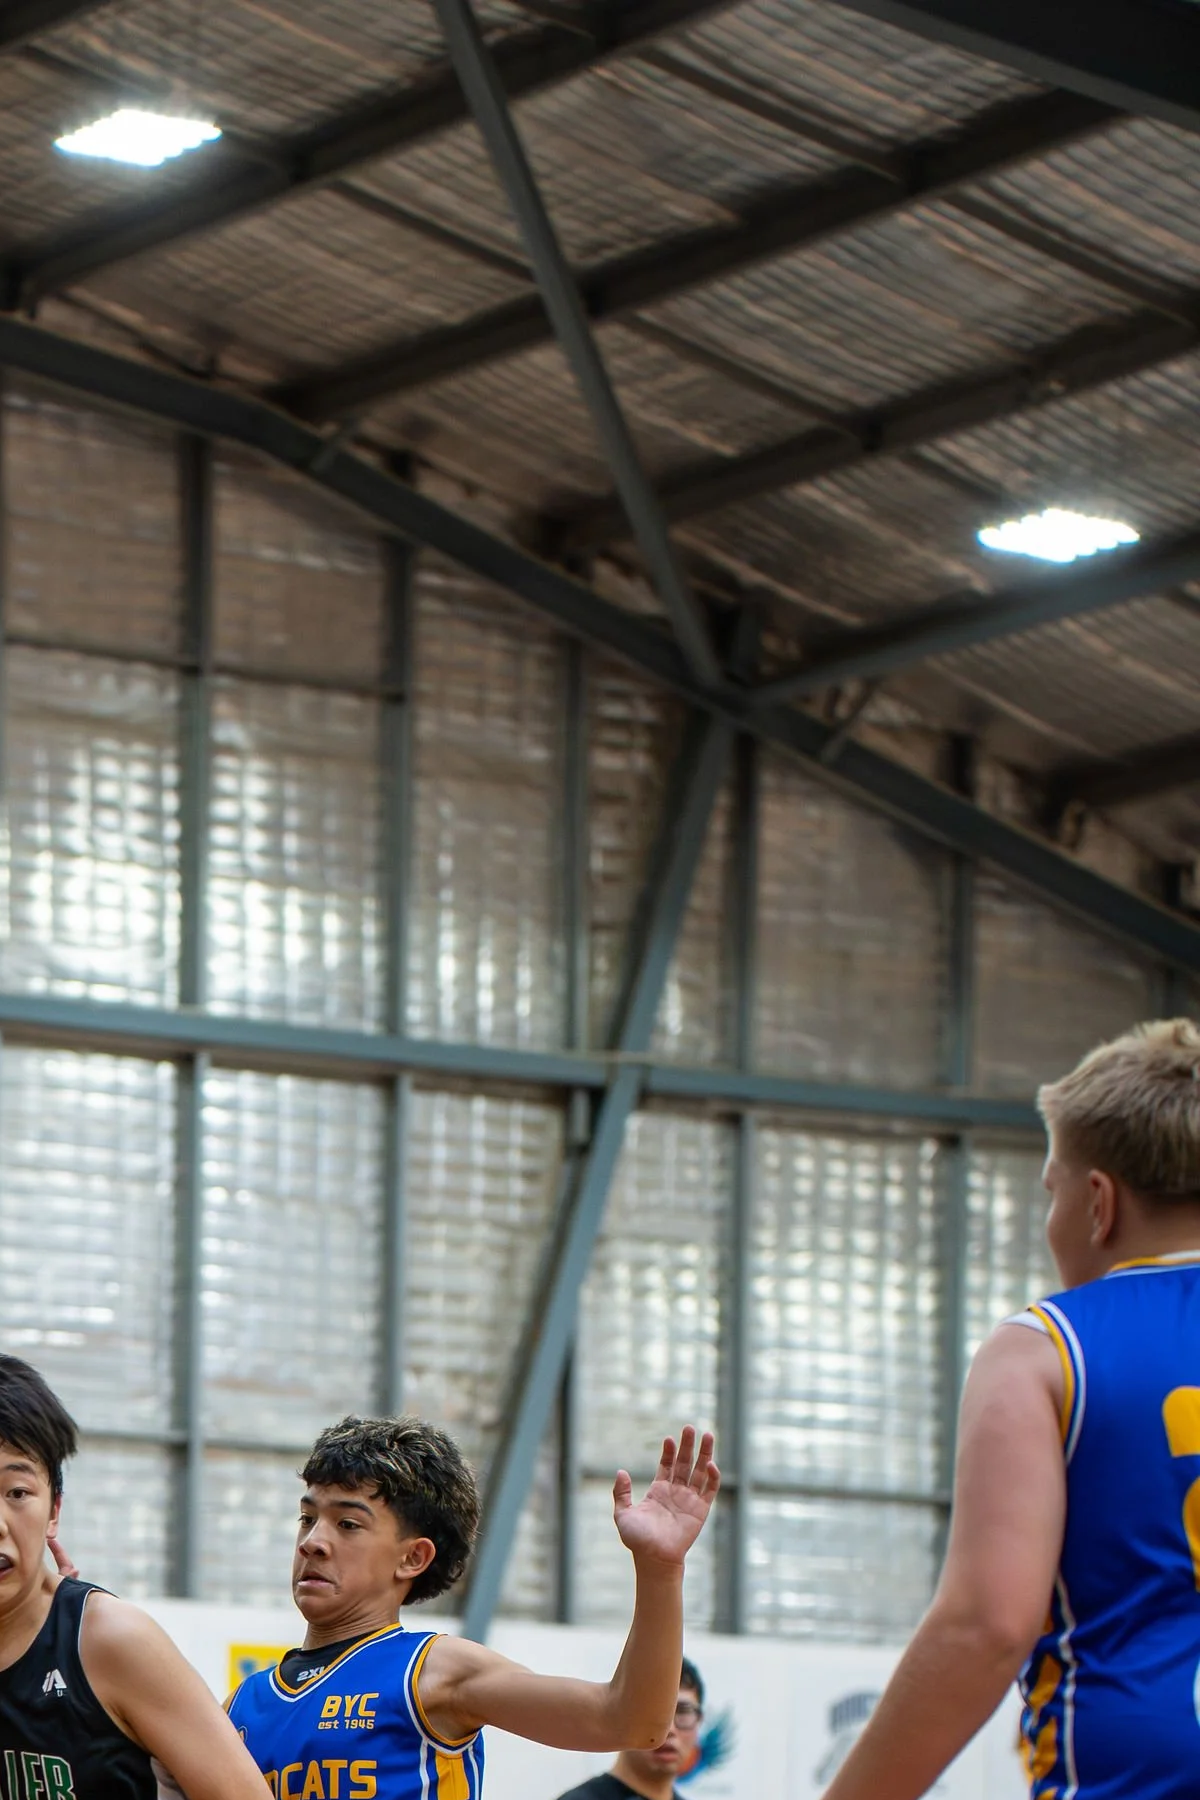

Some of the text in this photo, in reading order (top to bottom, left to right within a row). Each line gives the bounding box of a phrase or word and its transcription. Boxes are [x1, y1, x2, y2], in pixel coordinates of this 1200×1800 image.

[320, 1692, 380, 1718] BYC
[317, 1719, 375, 1730] est 1945
